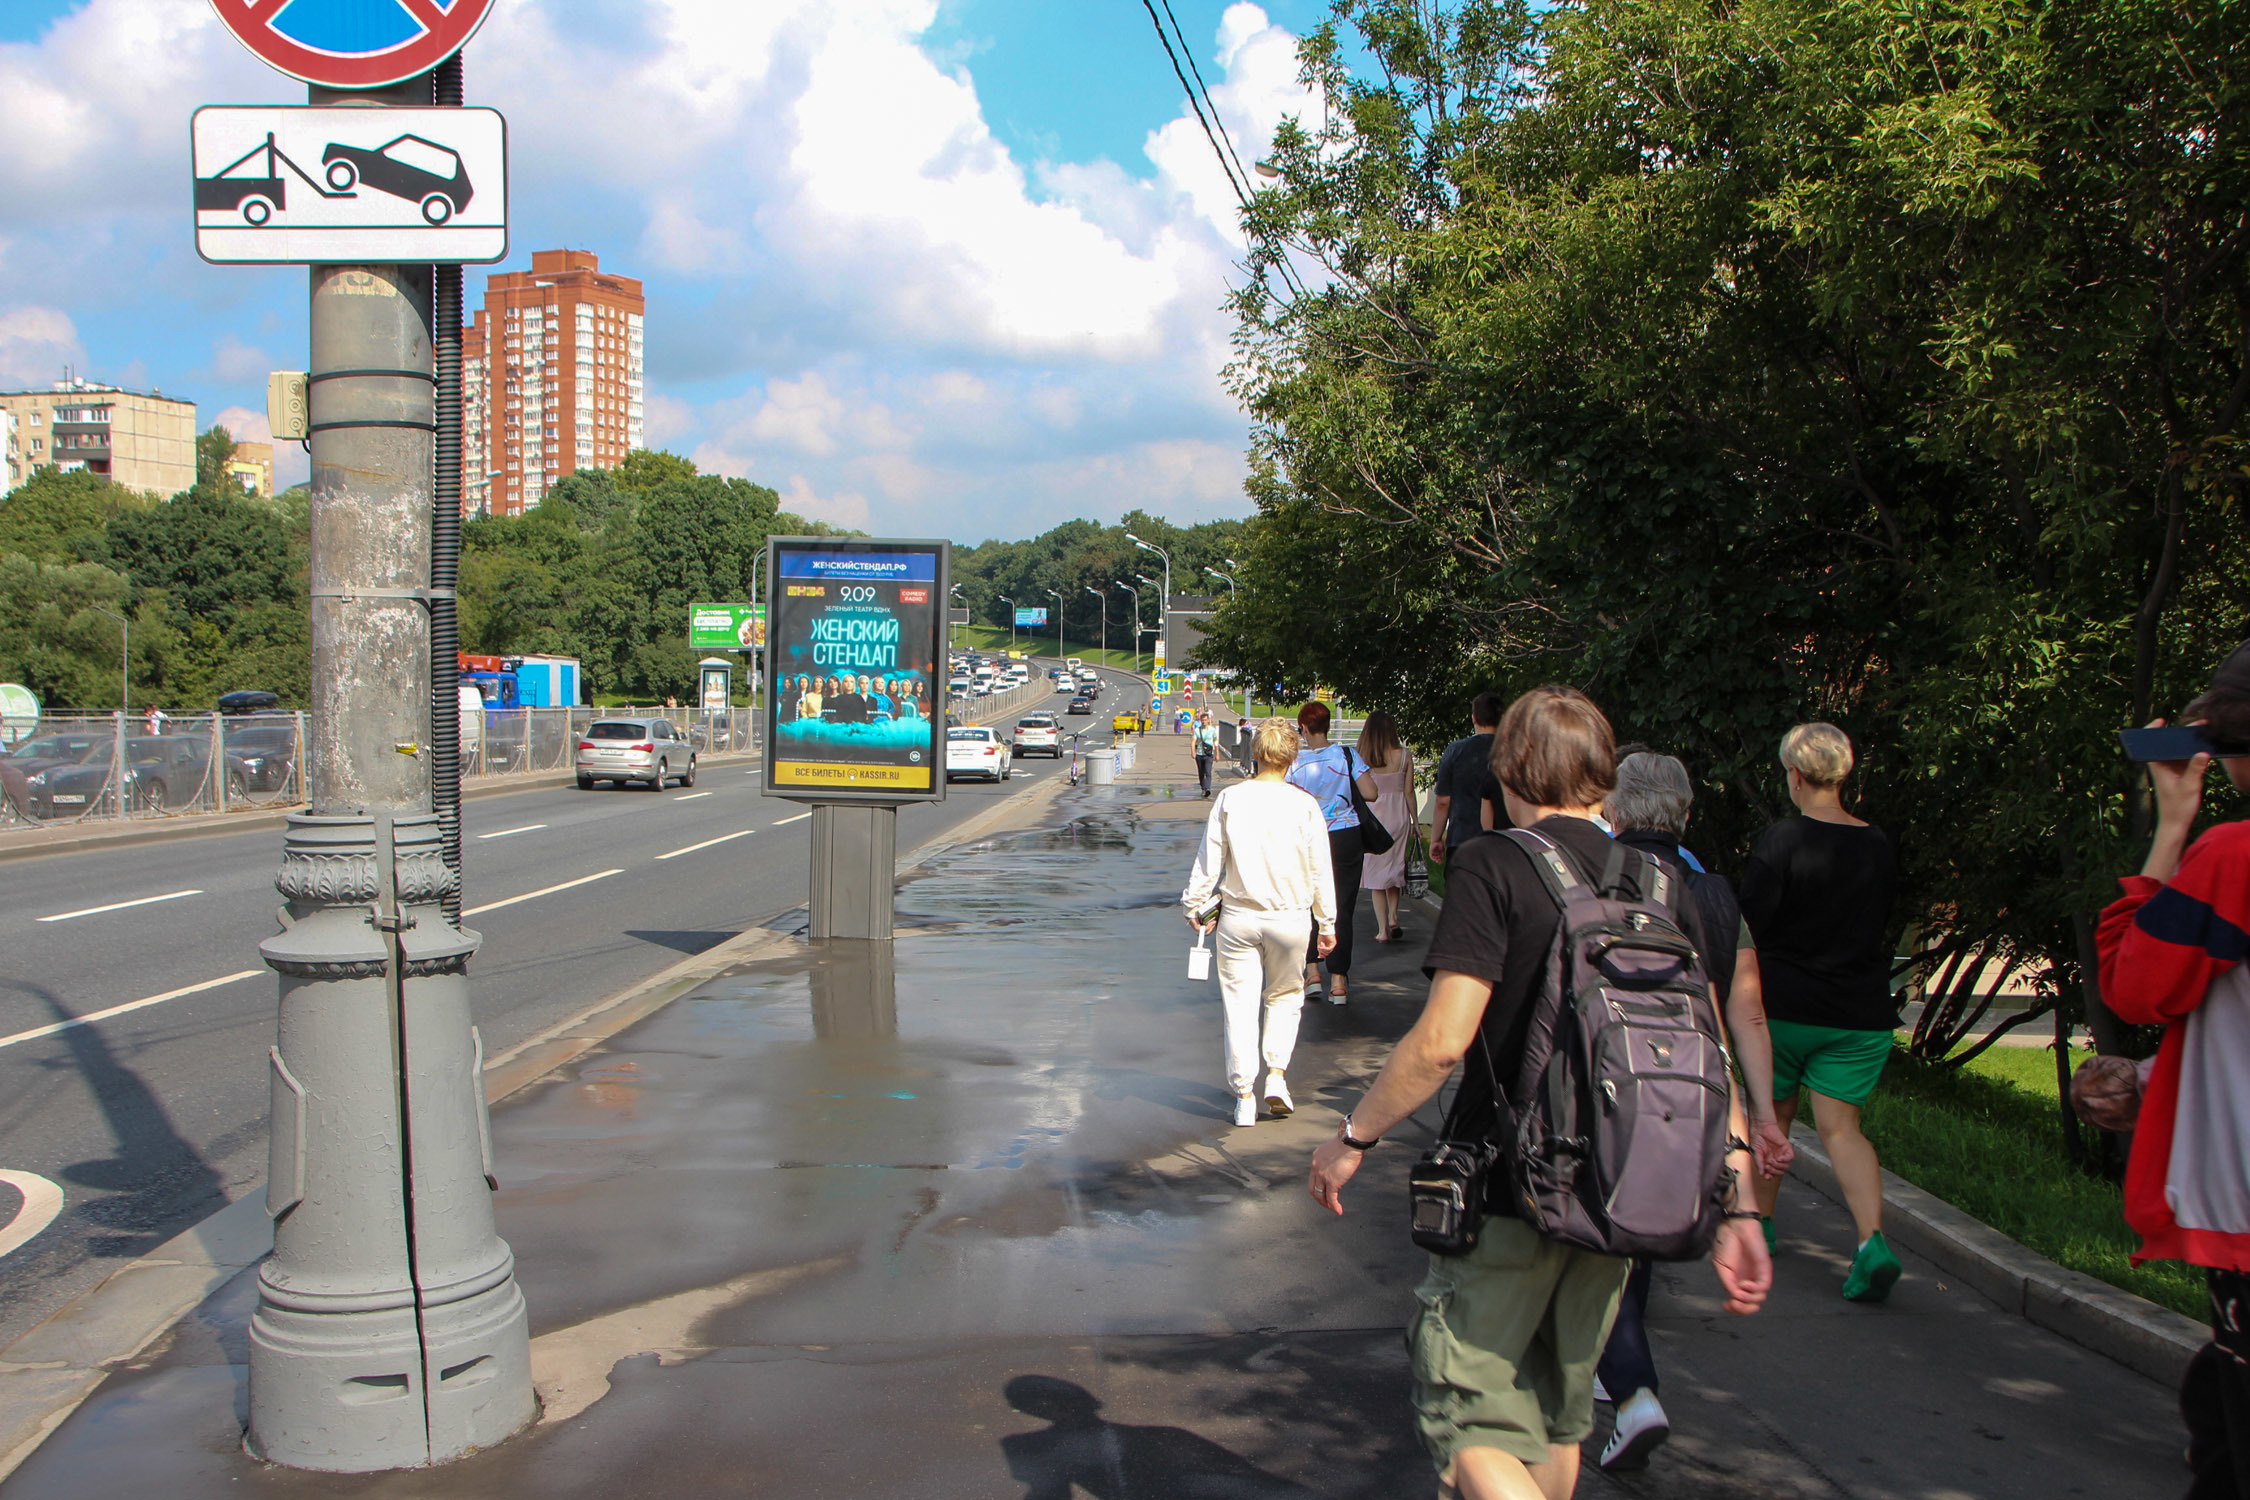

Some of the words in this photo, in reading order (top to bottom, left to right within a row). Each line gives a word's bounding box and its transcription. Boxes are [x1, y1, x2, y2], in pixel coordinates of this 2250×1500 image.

[812, 560, 907, 571] ЖЕНСКИЙСТЕНДАП.РФ
[840, 586, 876, 602] 9.09
[810, 618, 899, 643] ЖЕНСКИЙ
[813, 642, 896, 667] СТЕНДАП
[795, 767, 810, 776] ВСЕ
[812, 768, 845, 778] БИЛЕТЫ
[859, 770, 900, 780] KASSIR.RU
